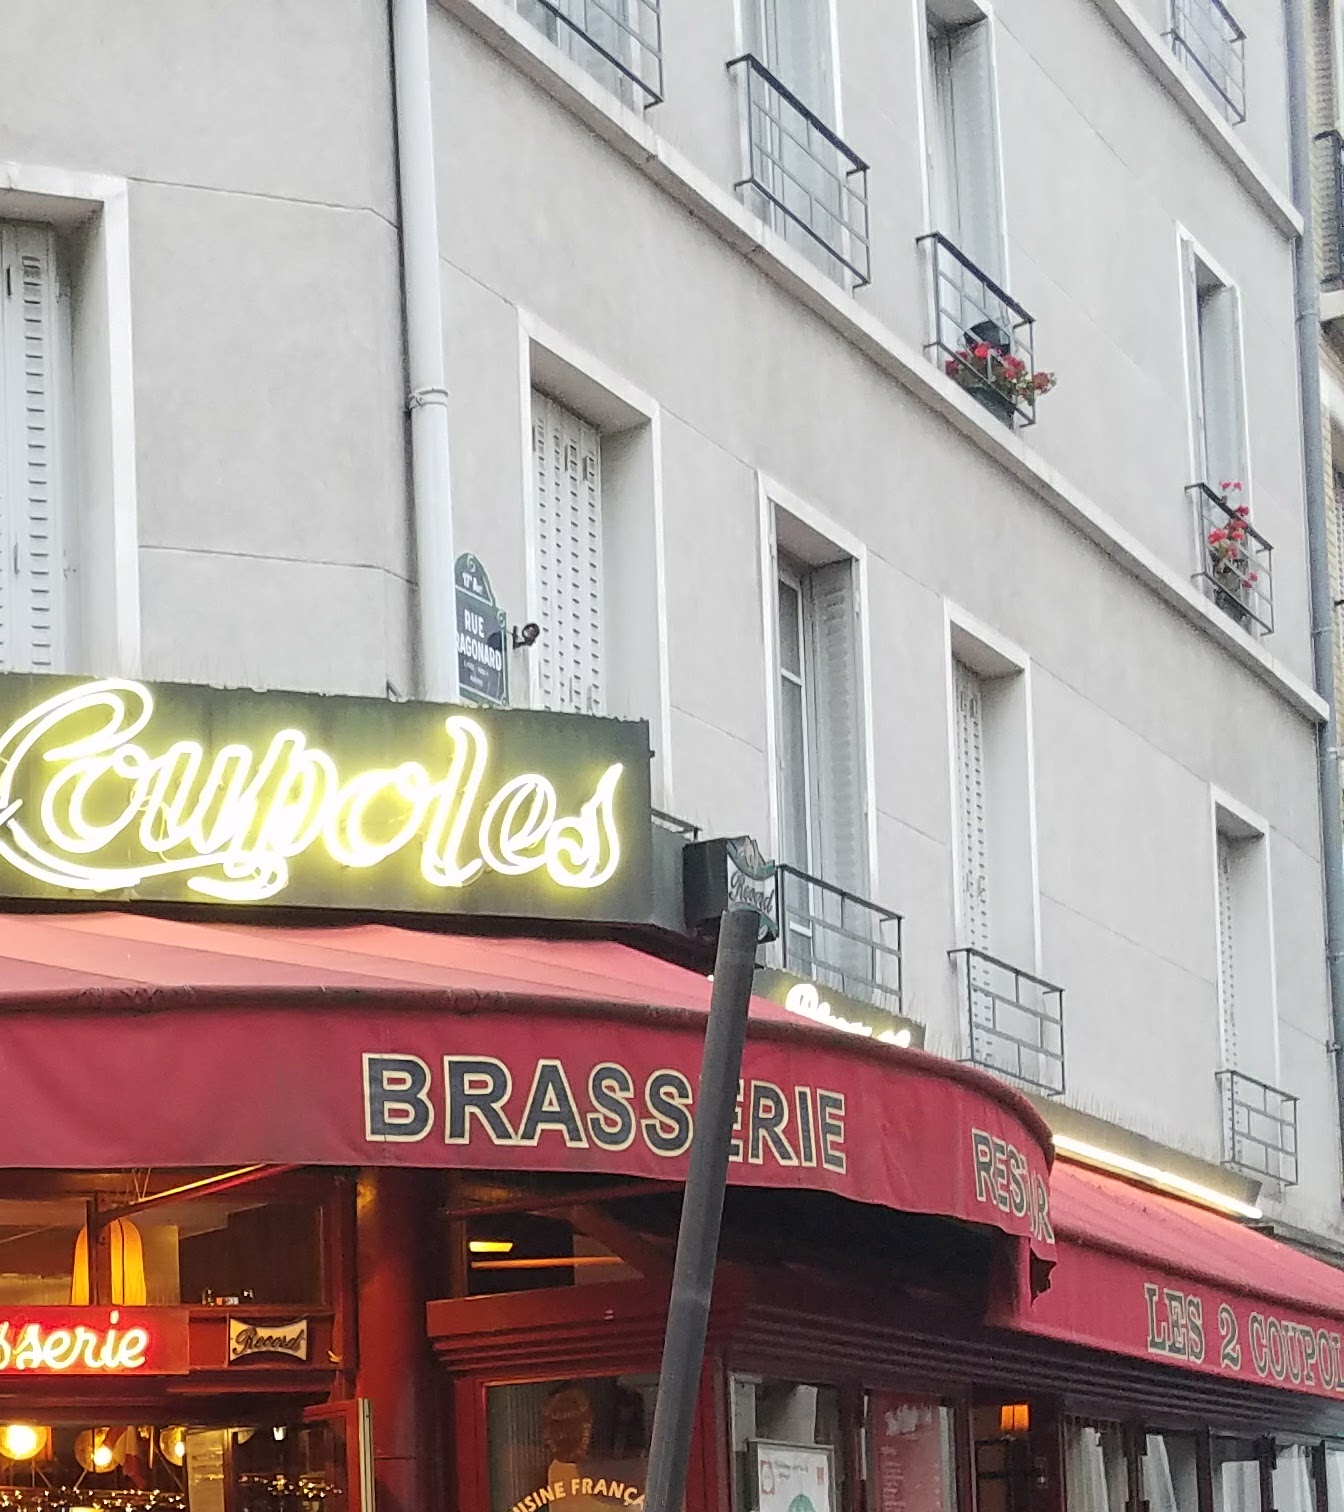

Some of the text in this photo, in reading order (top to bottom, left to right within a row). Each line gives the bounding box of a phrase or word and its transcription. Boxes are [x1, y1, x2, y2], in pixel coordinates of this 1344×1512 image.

[463, 608, 485, 639] RUE
[232, 1326, 306, 1356] Record
[1144, 1281, 1206, 1365] LES
[1217, 1302, 1242, 1372] 2
